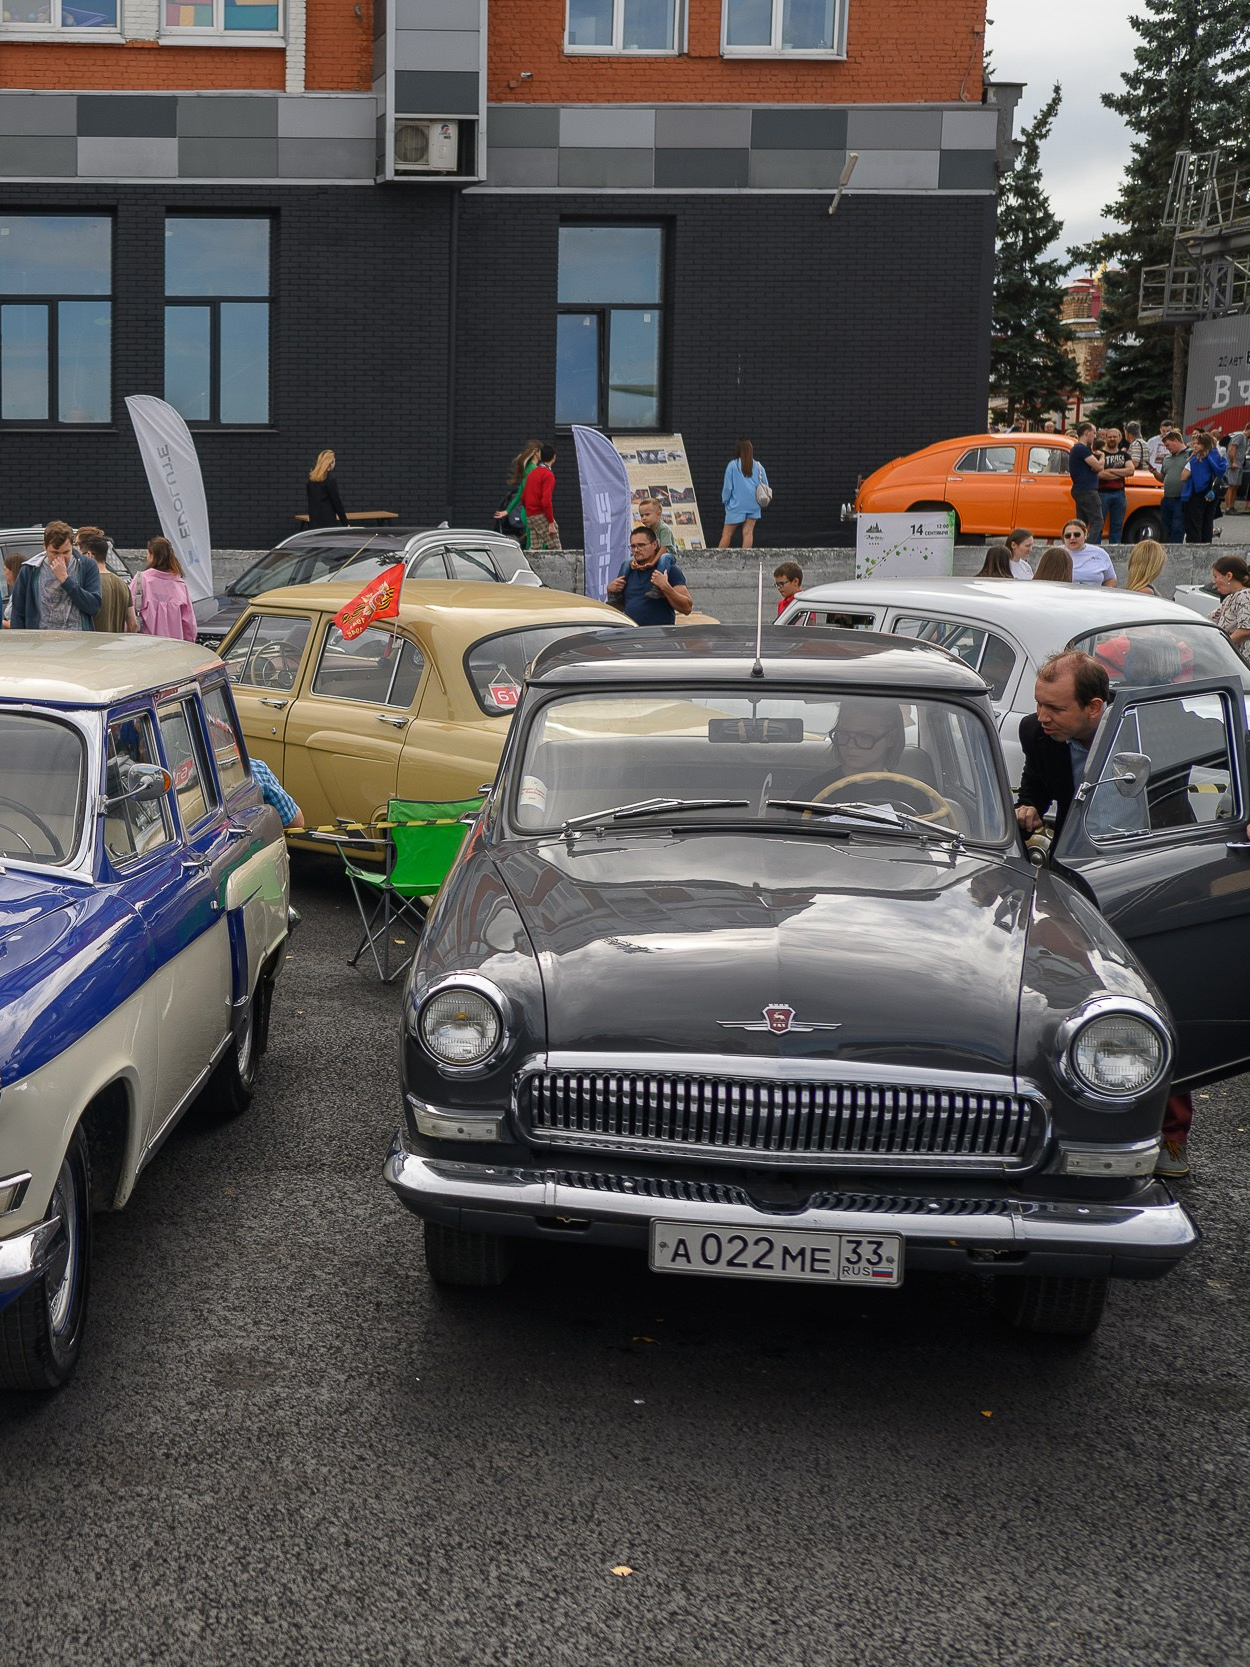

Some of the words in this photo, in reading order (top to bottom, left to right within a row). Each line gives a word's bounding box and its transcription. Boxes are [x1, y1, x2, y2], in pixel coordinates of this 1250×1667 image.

[910, 524, 924, 536] 14
[670, 1232, 832, 1274] А022МЕ
[845, 1239, 884, 1266] 33
[842, 1266, 871, 1276] RUS
